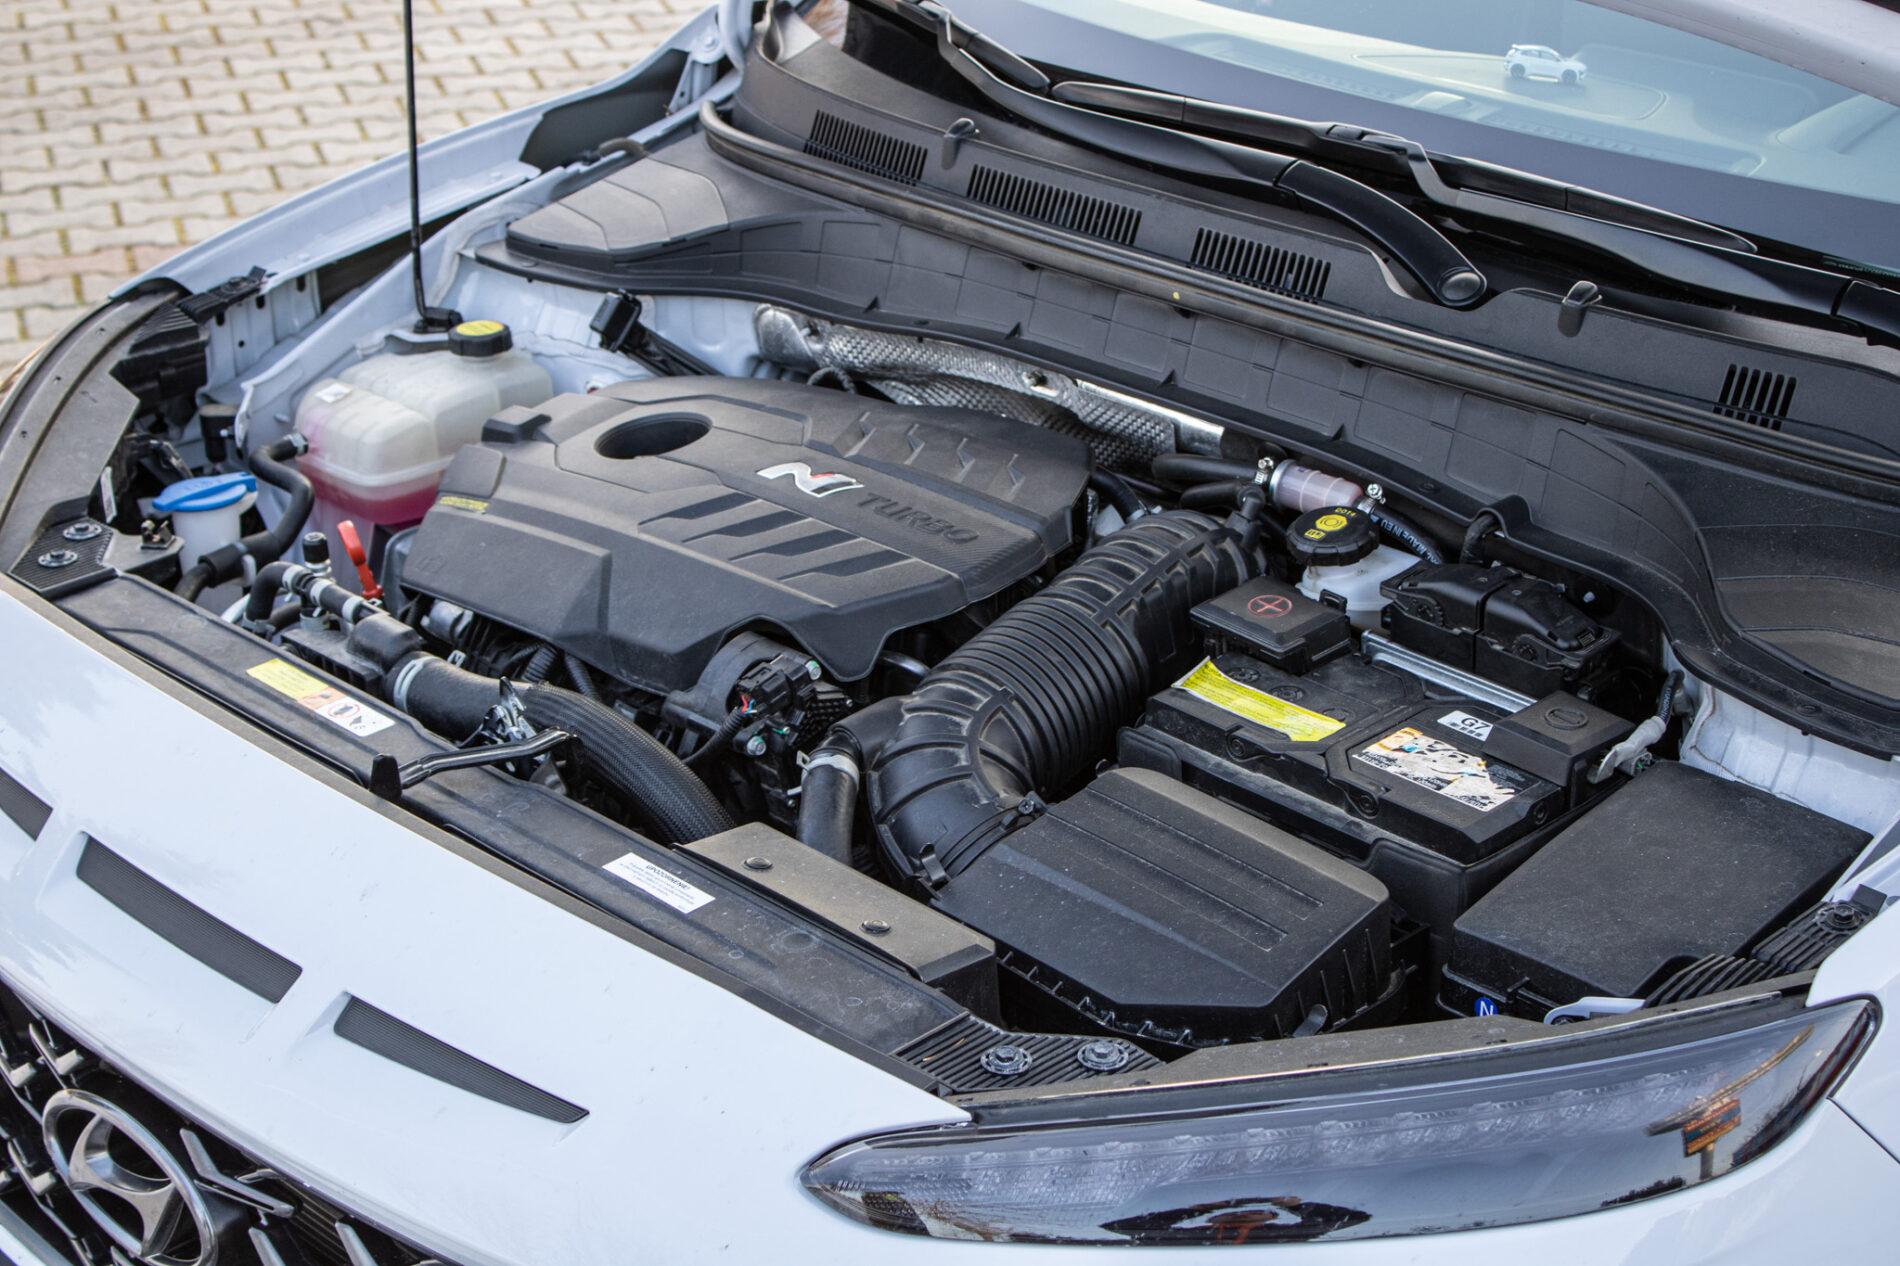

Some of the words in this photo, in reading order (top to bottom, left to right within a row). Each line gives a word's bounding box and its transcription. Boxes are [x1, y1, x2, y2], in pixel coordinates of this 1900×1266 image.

[857, 492, 979, 545] TURBO
[1380, 519, 1393, 531] EU
[1392, 525, 1402, 536] IN
[1460, 717, 1490, 730] G7
